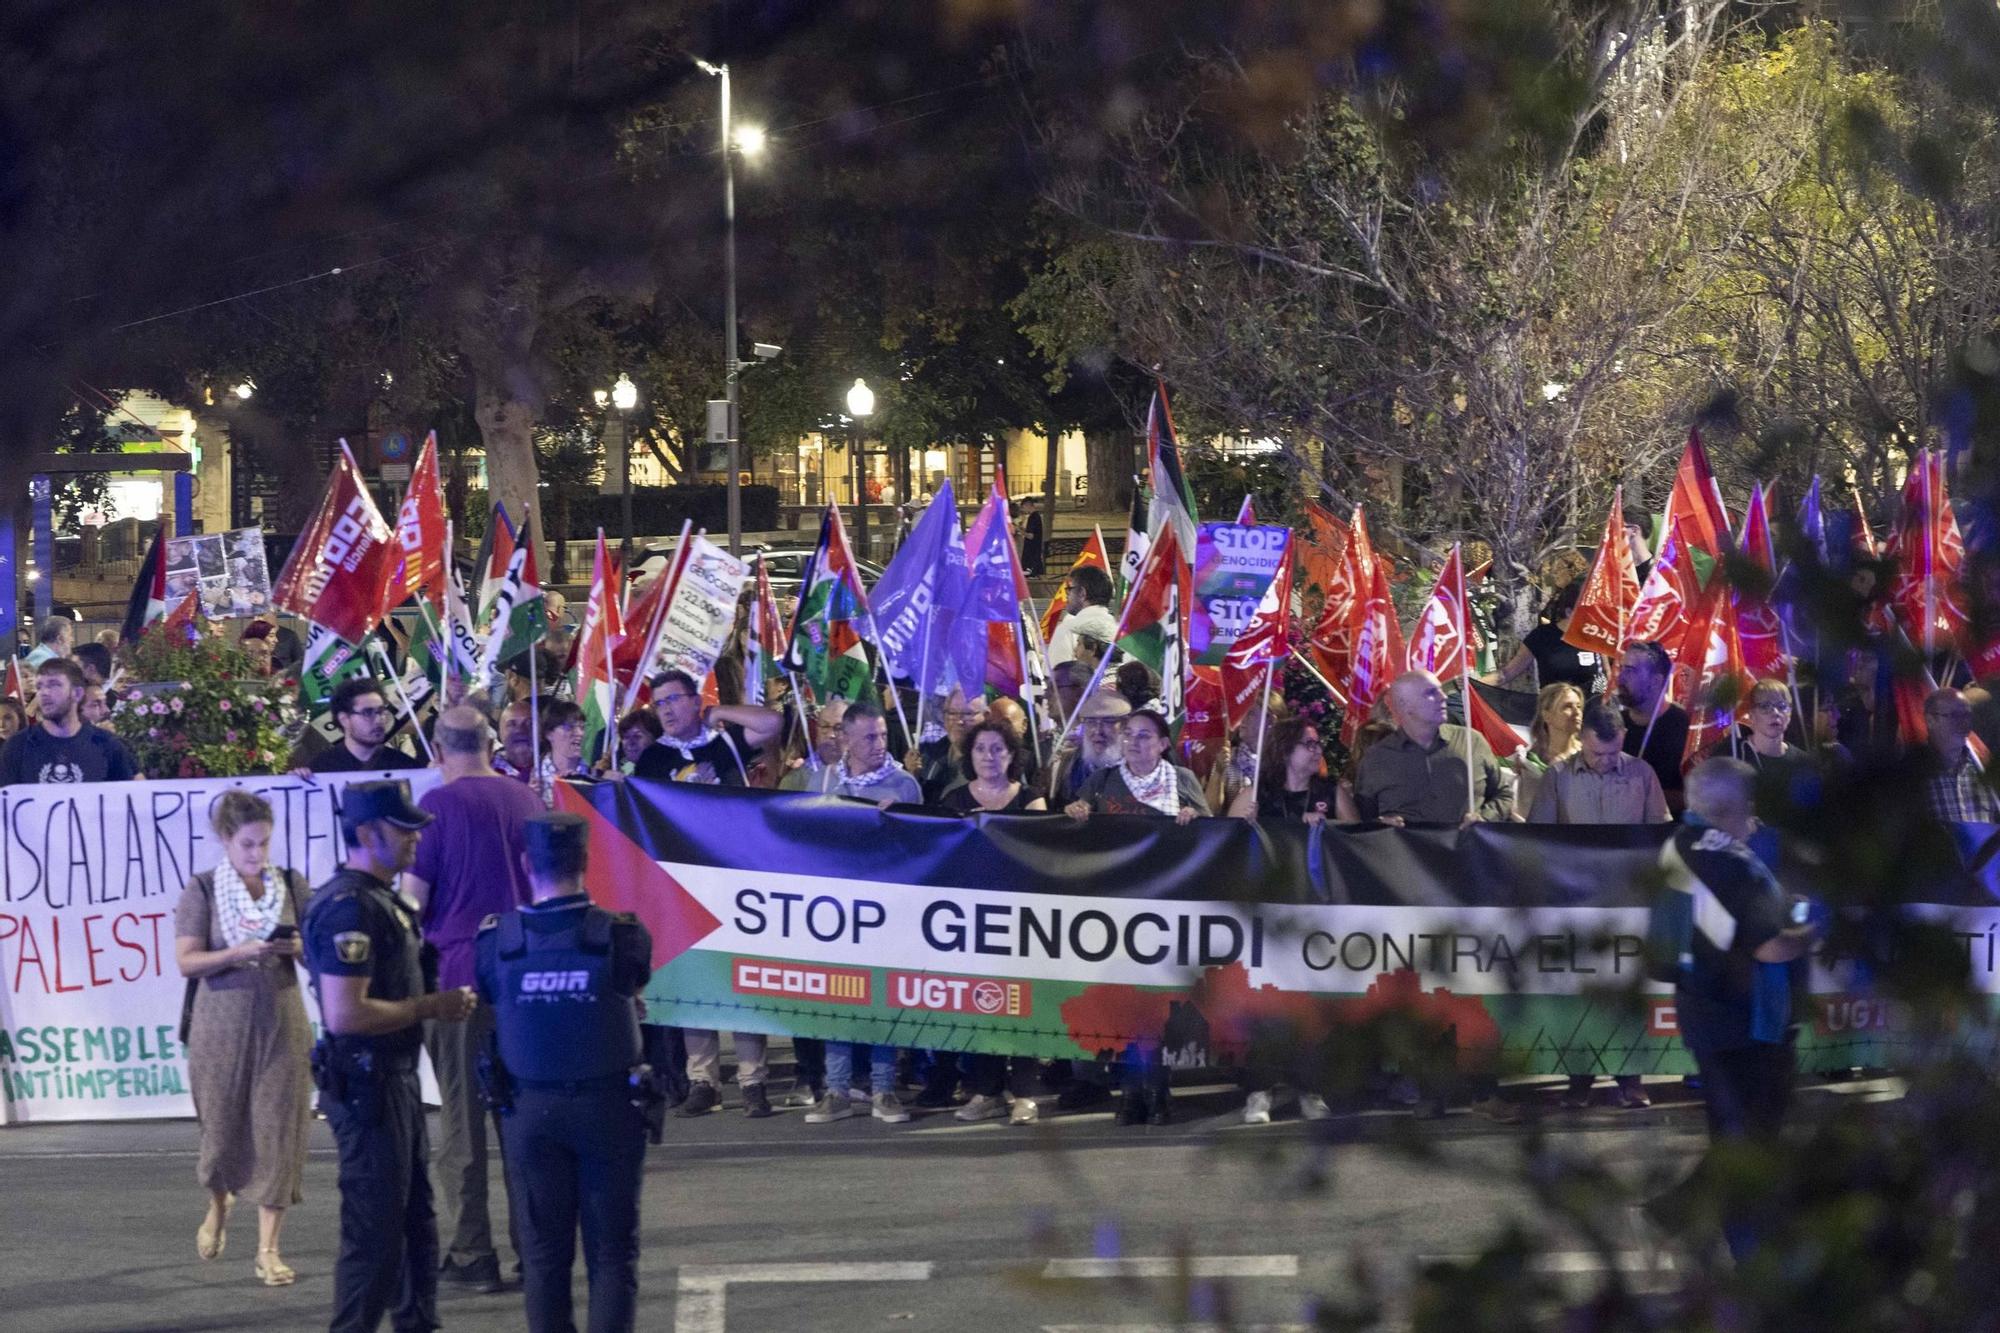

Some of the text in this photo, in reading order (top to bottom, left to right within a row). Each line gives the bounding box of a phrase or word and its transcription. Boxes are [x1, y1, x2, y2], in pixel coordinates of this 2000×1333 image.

[1213, 527, 1284, 550] STOP
[1209, 598, 1258, 620] STO
[734, 888, 887, 944] STOP
[921, 900, 1264, 968] GENOCIDI
[1302, 930, 1518, 974] CONTRA
[1538, 933, 1597, 974] EL
[0, 912, 167, 993] PALEST
[739, 965, 969, 1010] CCOO UGT
[0, 1025, 183, 1063] ASSEMBLE
